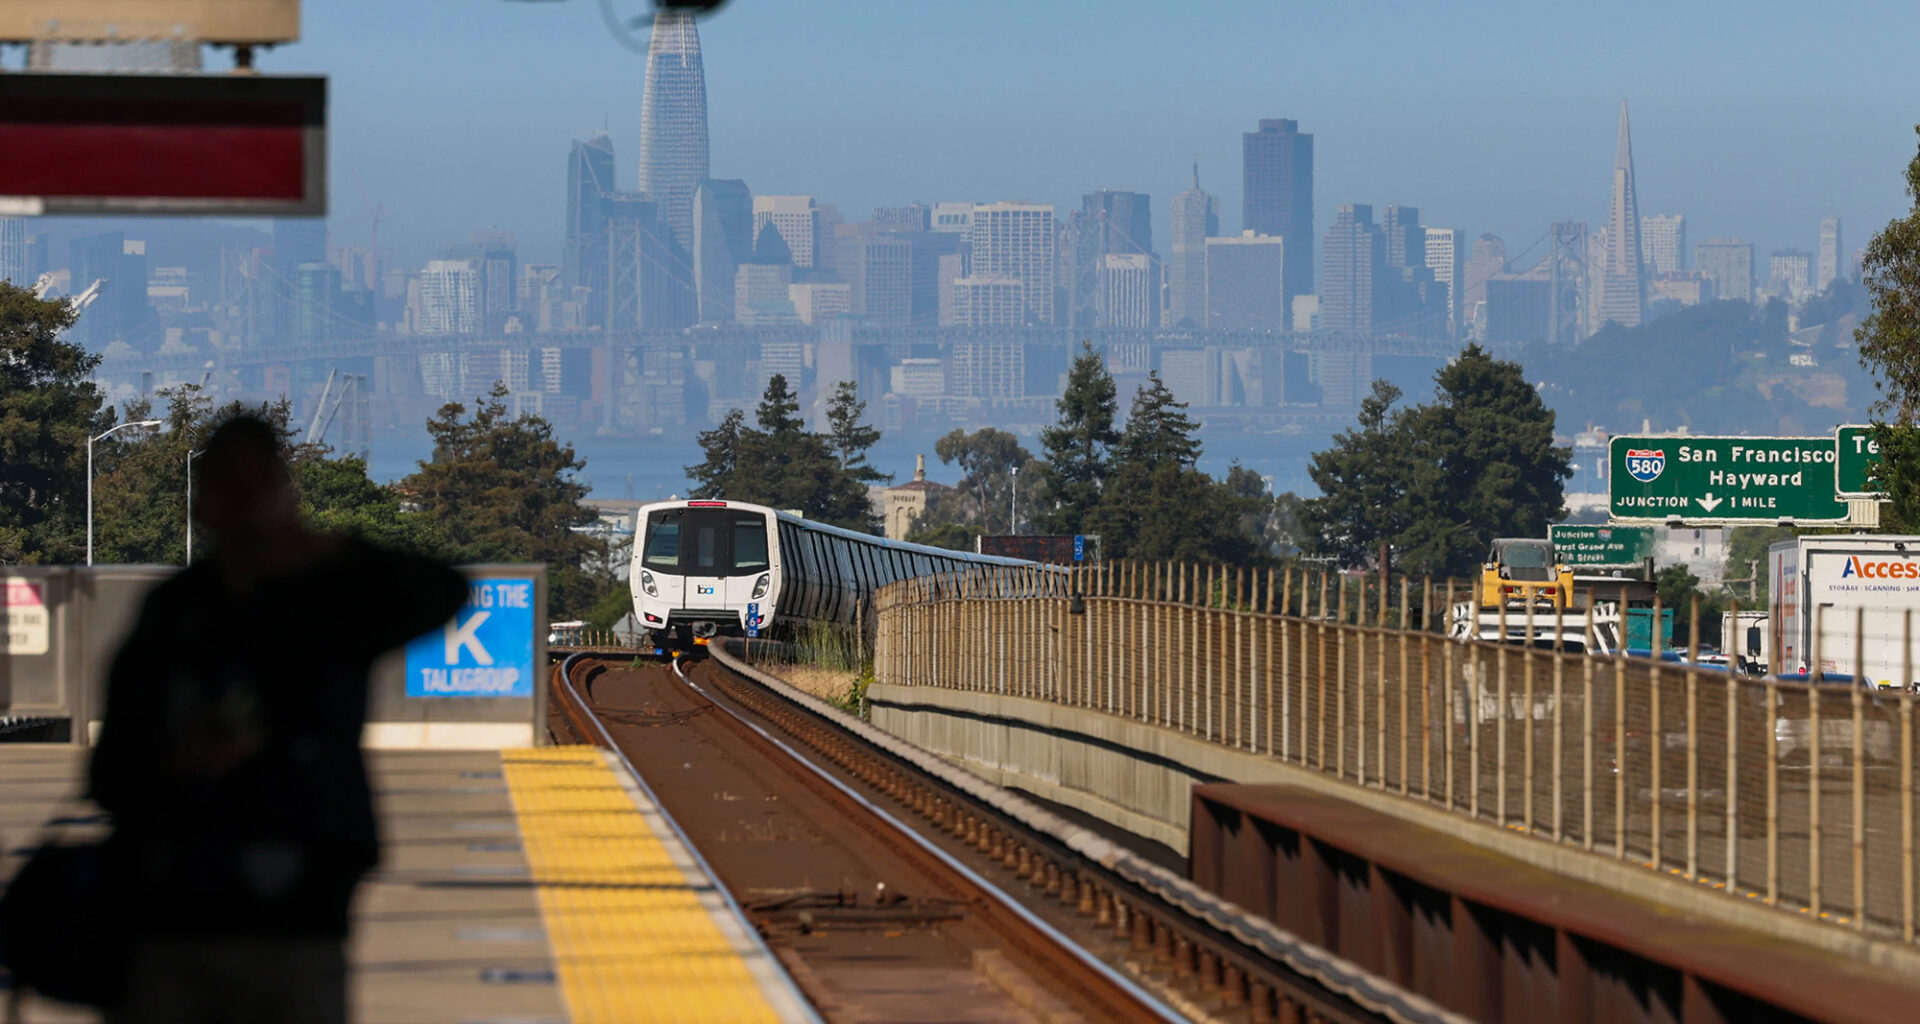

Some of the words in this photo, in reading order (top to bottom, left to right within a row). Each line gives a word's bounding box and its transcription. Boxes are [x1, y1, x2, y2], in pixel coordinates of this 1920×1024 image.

[1852, 436, 1880, 454] Te
[1679, 446, 1717, 462] San
[1732, 446, 1835, 463] Francisco
[1631, 459, 1661, 475] 580
[1710, 470, 1802, 490] Hayward
[1617, 496, 1688, 508] JUNCTION
[1731, 496, 1736, 508] 1
[1742, 497, 1776, 508] MILE
[1555, 530, 1595, 539] Junction
[1554, 543, 1576, 551] West
[1578, 543, 1605, 551] Grand
[1842, 555, 1920, 579] Acces
[497, 584, 529, 608] THE
[749, 617, 756, 627] 6
[445, 611, 494, 665] K
[421, 667, 519, 692] TALKGROUP
